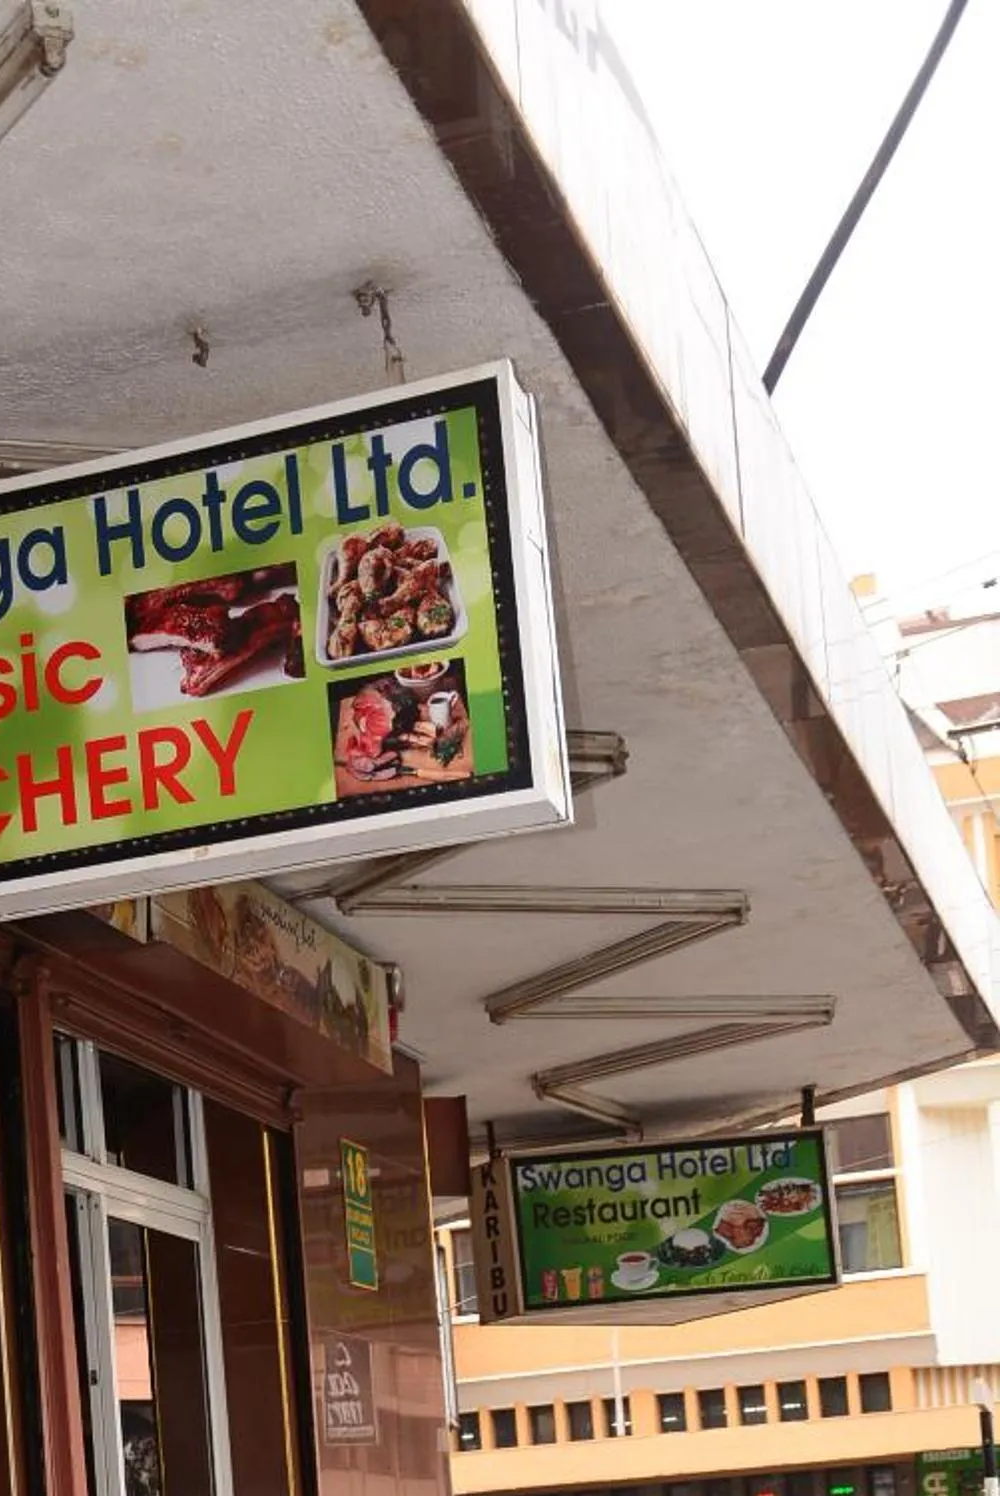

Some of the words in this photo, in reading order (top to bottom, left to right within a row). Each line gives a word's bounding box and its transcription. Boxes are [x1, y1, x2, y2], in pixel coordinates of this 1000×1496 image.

[93, 455, 304, 577] Hotel
[331, 419, 477, 526] Ltd.
[521, 1160, 647, 1193] Swanga
[656, 1147, 737, 1180] Hotel
[747, 1141, 794, 1171] Ltd
[532, 1187, 703, 1230] Restaurant
[481, 1165, 508, 1316] KARIBU
